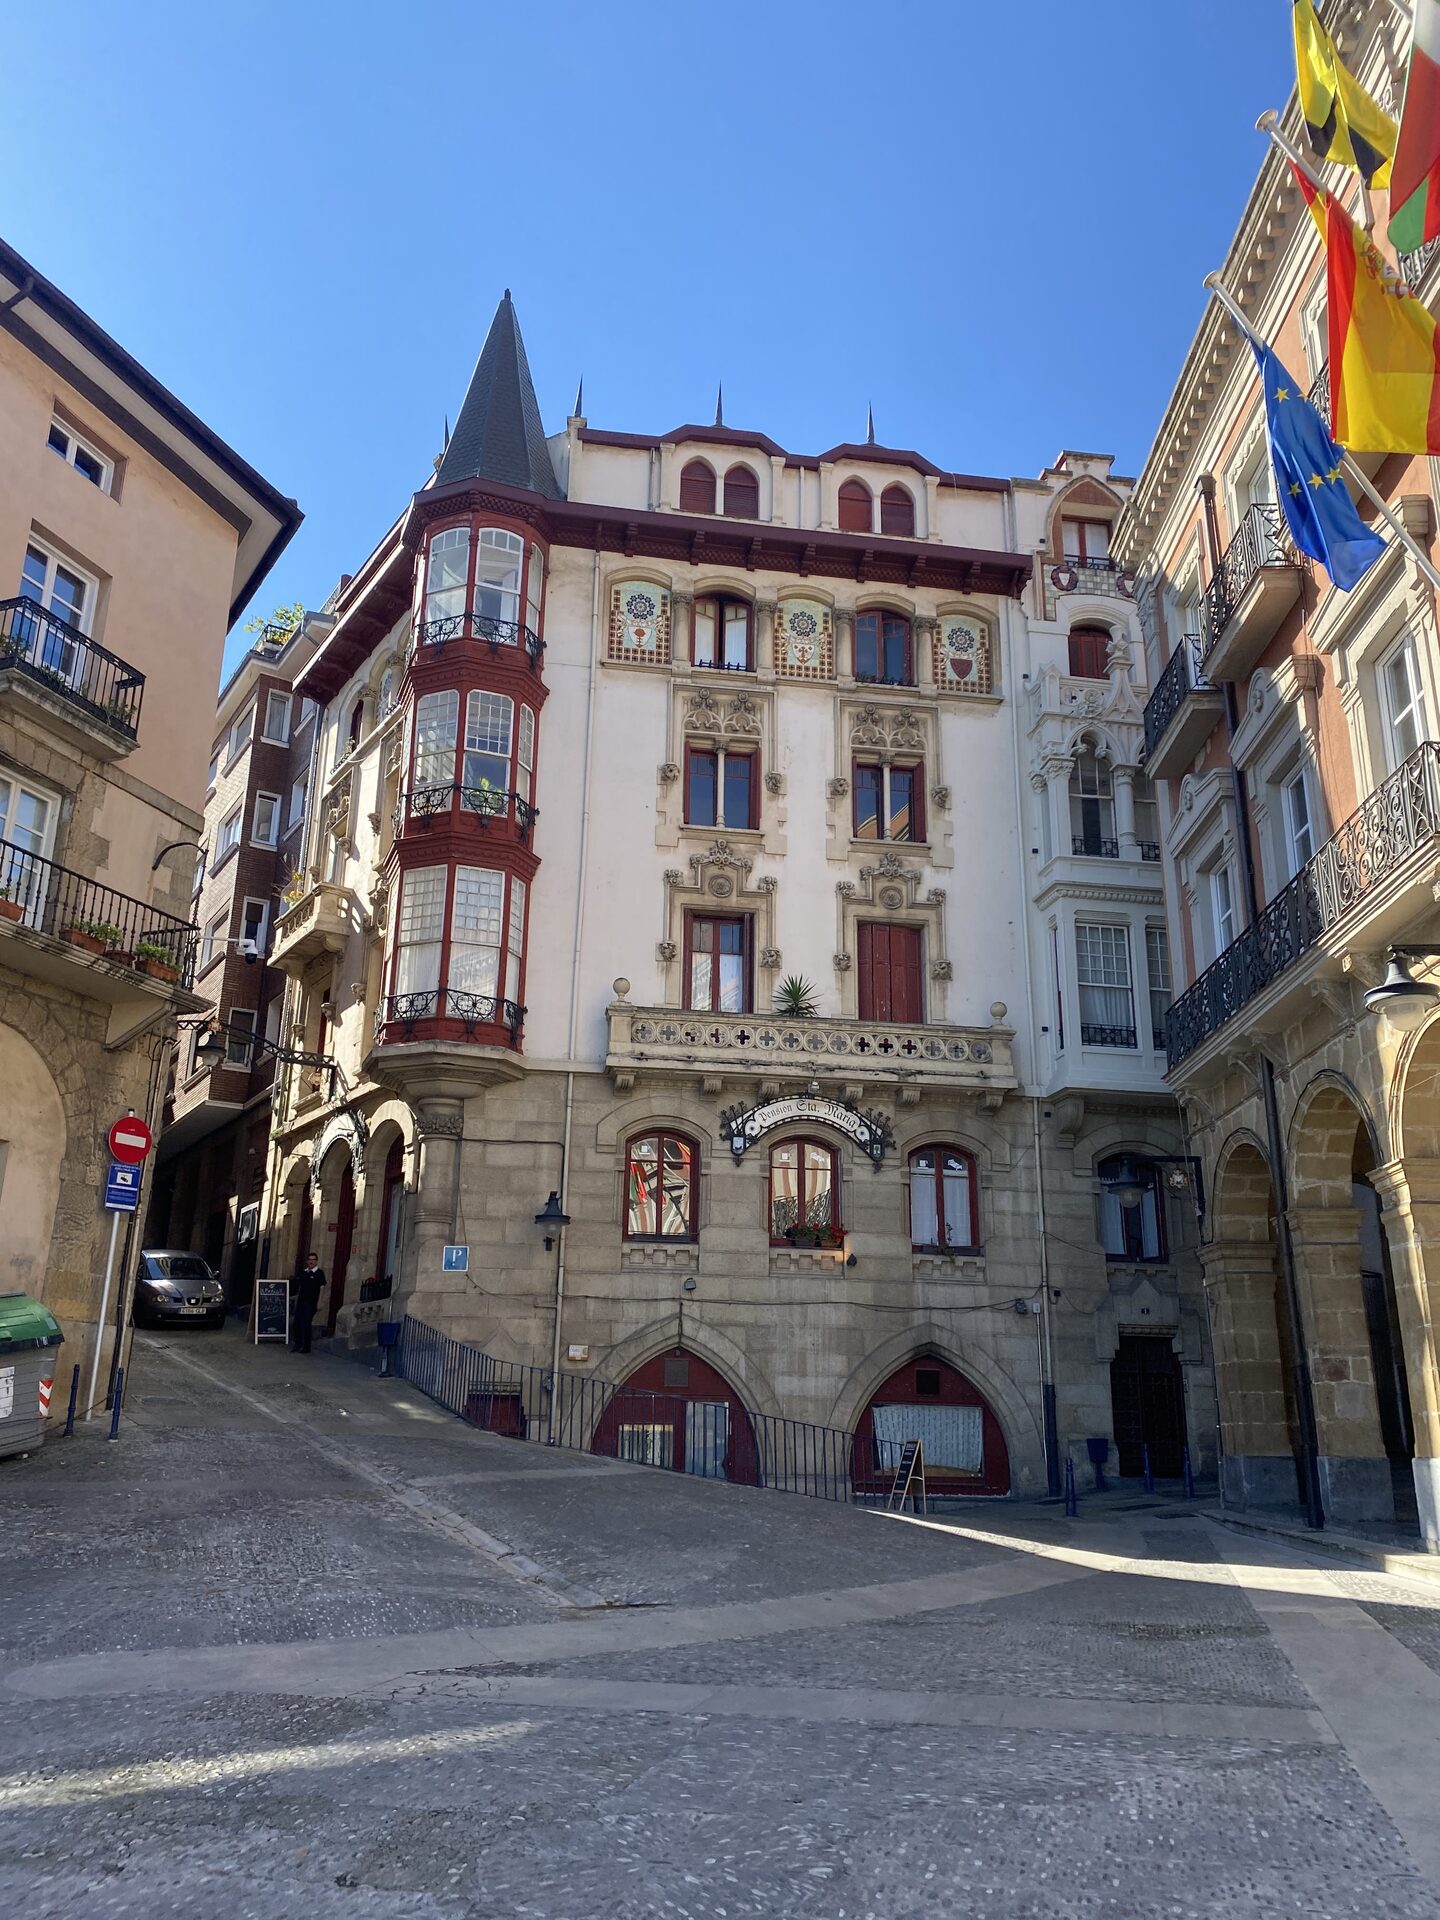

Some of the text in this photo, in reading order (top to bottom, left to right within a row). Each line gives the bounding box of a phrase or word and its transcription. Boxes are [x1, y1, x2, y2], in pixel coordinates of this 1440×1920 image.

[758, 1099, 856, 1128] Pensión Sta. María
